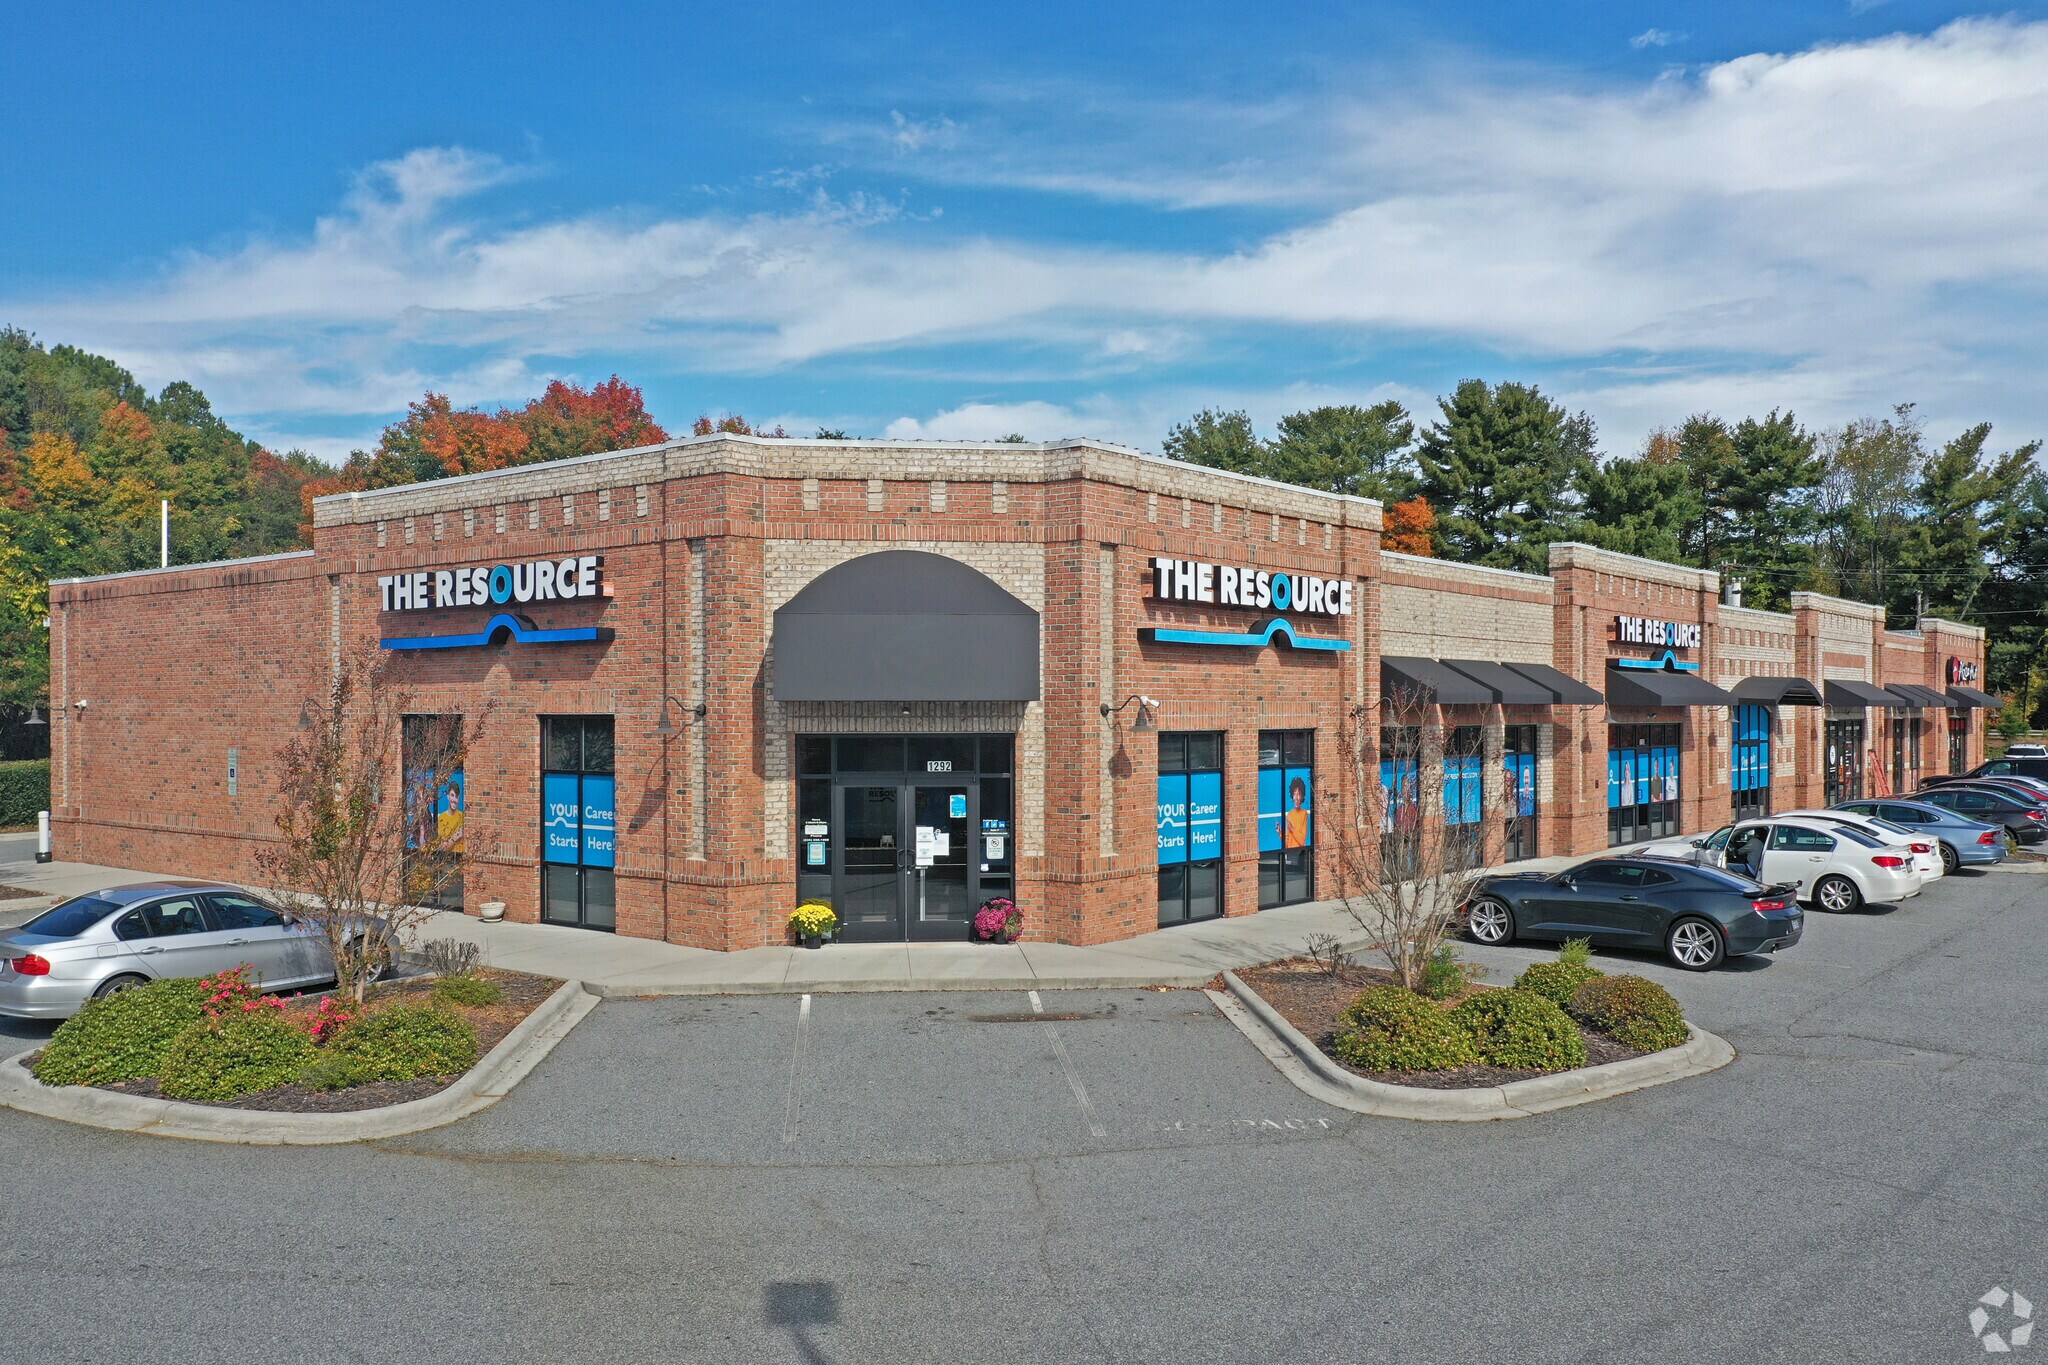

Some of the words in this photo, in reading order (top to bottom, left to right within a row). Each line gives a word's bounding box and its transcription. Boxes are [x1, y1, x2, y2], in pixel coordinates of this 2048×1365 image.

[377, 572, 428, 611] THE
[435, 556, 597, 608] RESOURCE
[1155, 557, 1214, 604] THE
[1220, 565, 1353, 616] RESOURCE
[1619, 615, 1643, 643] THE
[1644, 619, 1701, 648] RESOURCE
[928, 761, 951, 771] 1292
[549, 803, 579, 818] YOUR
[1157, 803, 1186, 818] YOUR
[1190, 802, 1218, 815] Career
[549, 833, 579, 848] Starts
[587, 836, 616, 851] Here!
[1157, 834, 1185, 848] Starts
[1192, 829, 1217, 844] Here!
